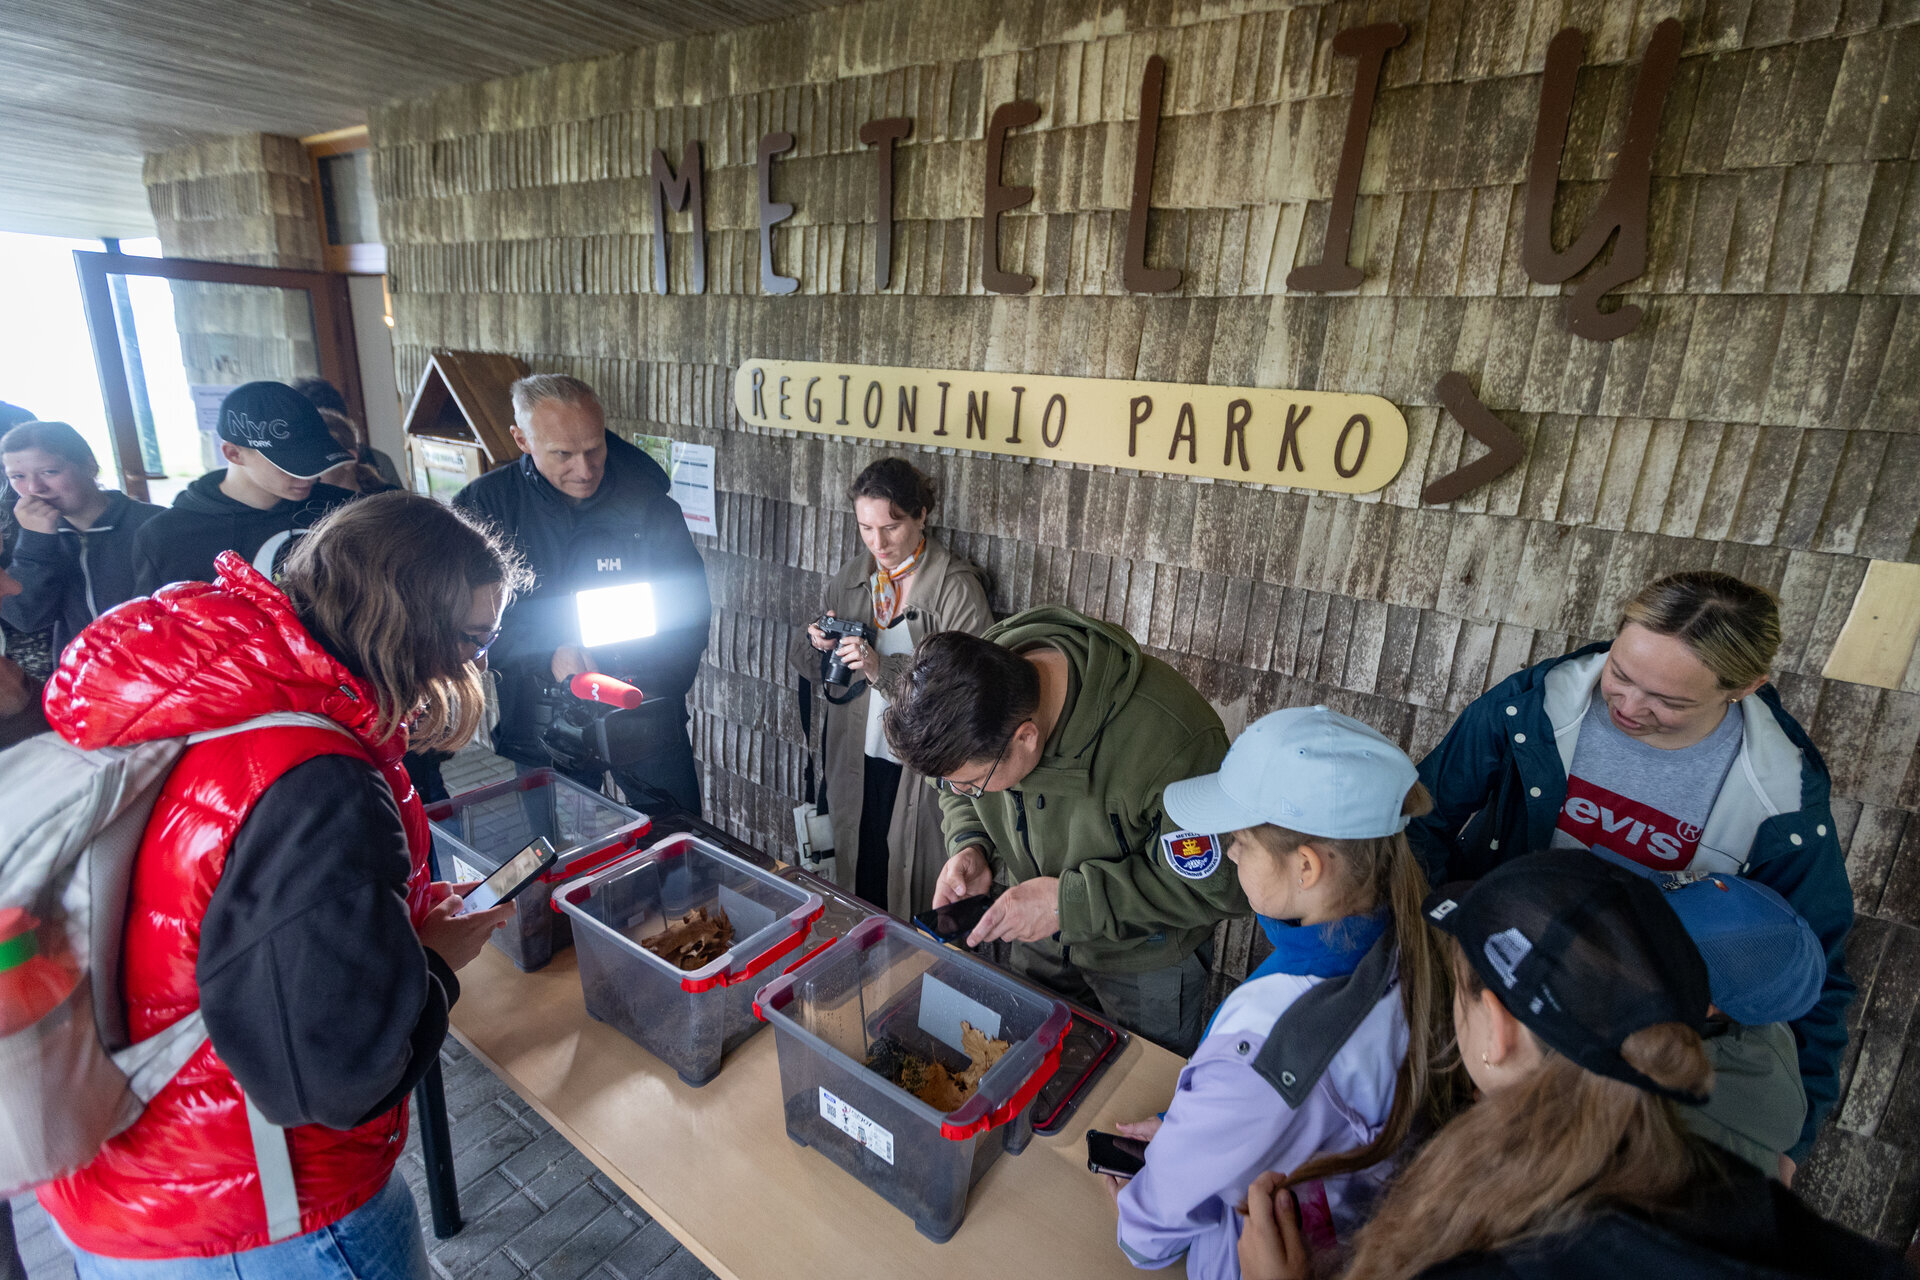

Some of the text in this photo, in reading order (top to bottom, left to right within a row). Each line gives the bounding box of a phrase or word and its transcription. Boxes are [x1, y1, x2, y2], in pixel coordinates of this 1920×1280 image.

[651, 17, 1684, 341] METELIŲ
[227, 410, 290, 440] NYC
[750, 366, 1371, 478] REGIONINIO PARKO
[596, 558, 622, 571] HH
